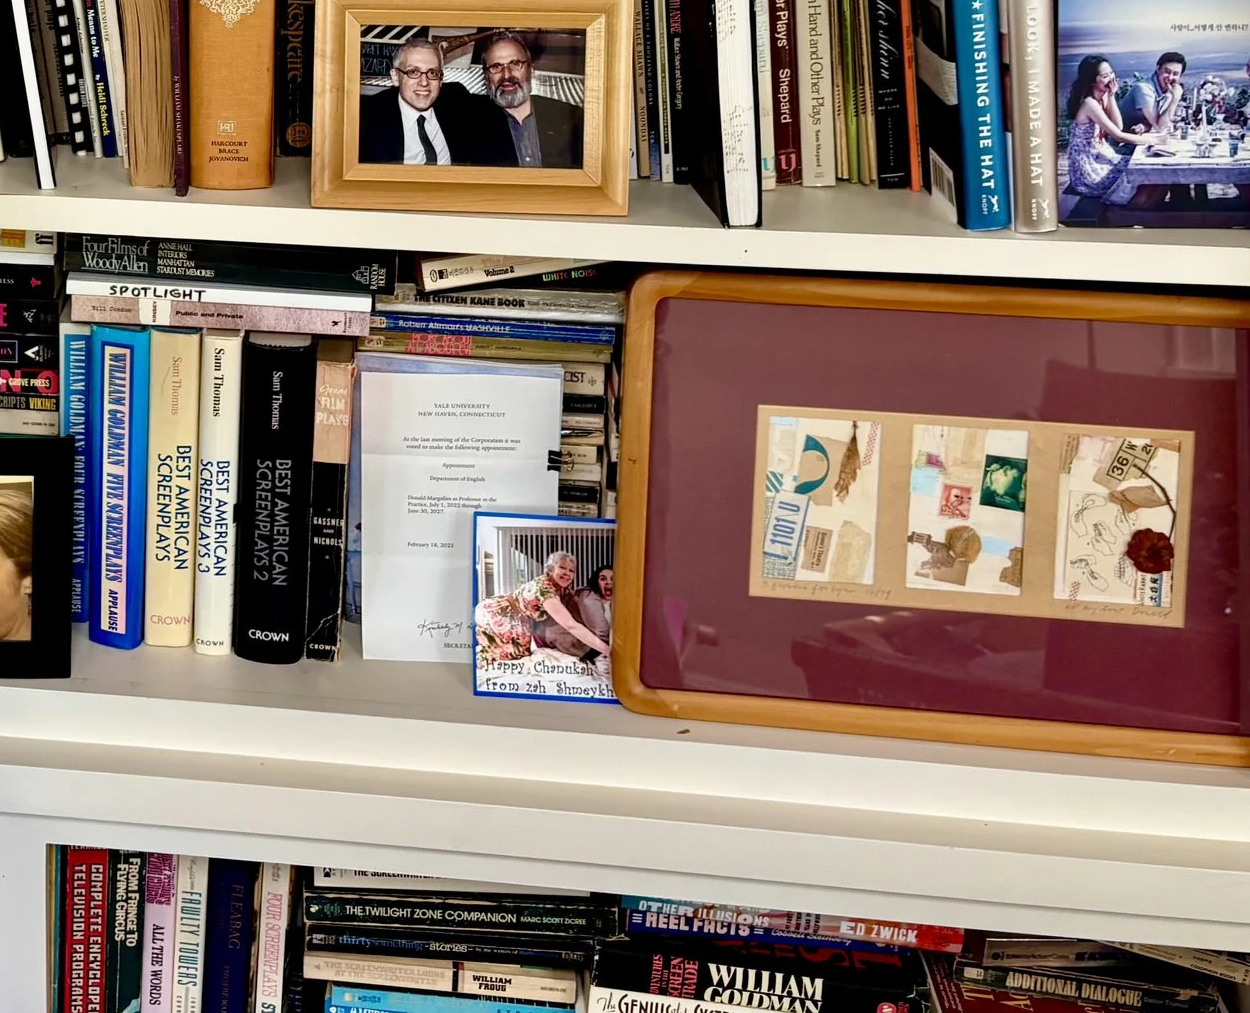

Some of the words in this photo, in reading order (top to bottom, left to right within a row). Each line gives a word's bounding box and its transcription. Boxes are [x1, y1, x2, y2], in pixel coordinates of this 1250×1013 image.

[774, 11, 789, 48] Plays
[972, 3, 990, 108] FINISHING
[778, 68, 792, 124] Shepard
[978, 112, 993, 149] THE
[980, 152, 995, 190] HAT
[109, 285, 207, 302] SPOTLIGHT
[212, 347, 225, 373] Sam
[29, 397, 56, 410] VIKING
[212, 375, 224, 417] Thomas
[176, 445, 192, 481] BEST
[216, 460, 230, 494] BEST
[275, 459, 292, 496] BEST
[155, 453, 173, 562] SCREENPLAYS
[197, 459, 213, 559] SCREENPLAYS
[254, 459, 272, 566] SCREENPLAYS
[174, 484, 190, 571] AMERICAN
[213, 499, 228, 577] AMERICAN
[272, 498, 291, 586] AMERICAN
[197, 563, 209, 573] 3
[254, 569, 269, 581] 2
[485, 657, 525, 675] Happy
[534, 659, 594, 676] Chanukah
[485, 678, 519, 692] from
[526, 680, 546, 694] zah
[72, 864, 86, 940] TELEVISION
[89, 864, 103, 932] COMPLETE
[345, 904, 363, 915] THE
[365, 904, 411, 918] TWILIGHT
[413, 907, 443, 919] ZONE
[445, 910, 517, 923] COMPANION
[152, 924, 165, 943] ALL
[151, 943, 164, 966] THE
[177, 942, 199, 987] TOWERS
[71, 944, 84, 1013] PROGRAMS
[149, 966, 163, 1006] WORDS
[707, 962, 825, 1002] WILLIAM
[1005, 971, 1080, 997] ADDITIONAL
[1081, 982, 1143, 1006] DIALOGUE
